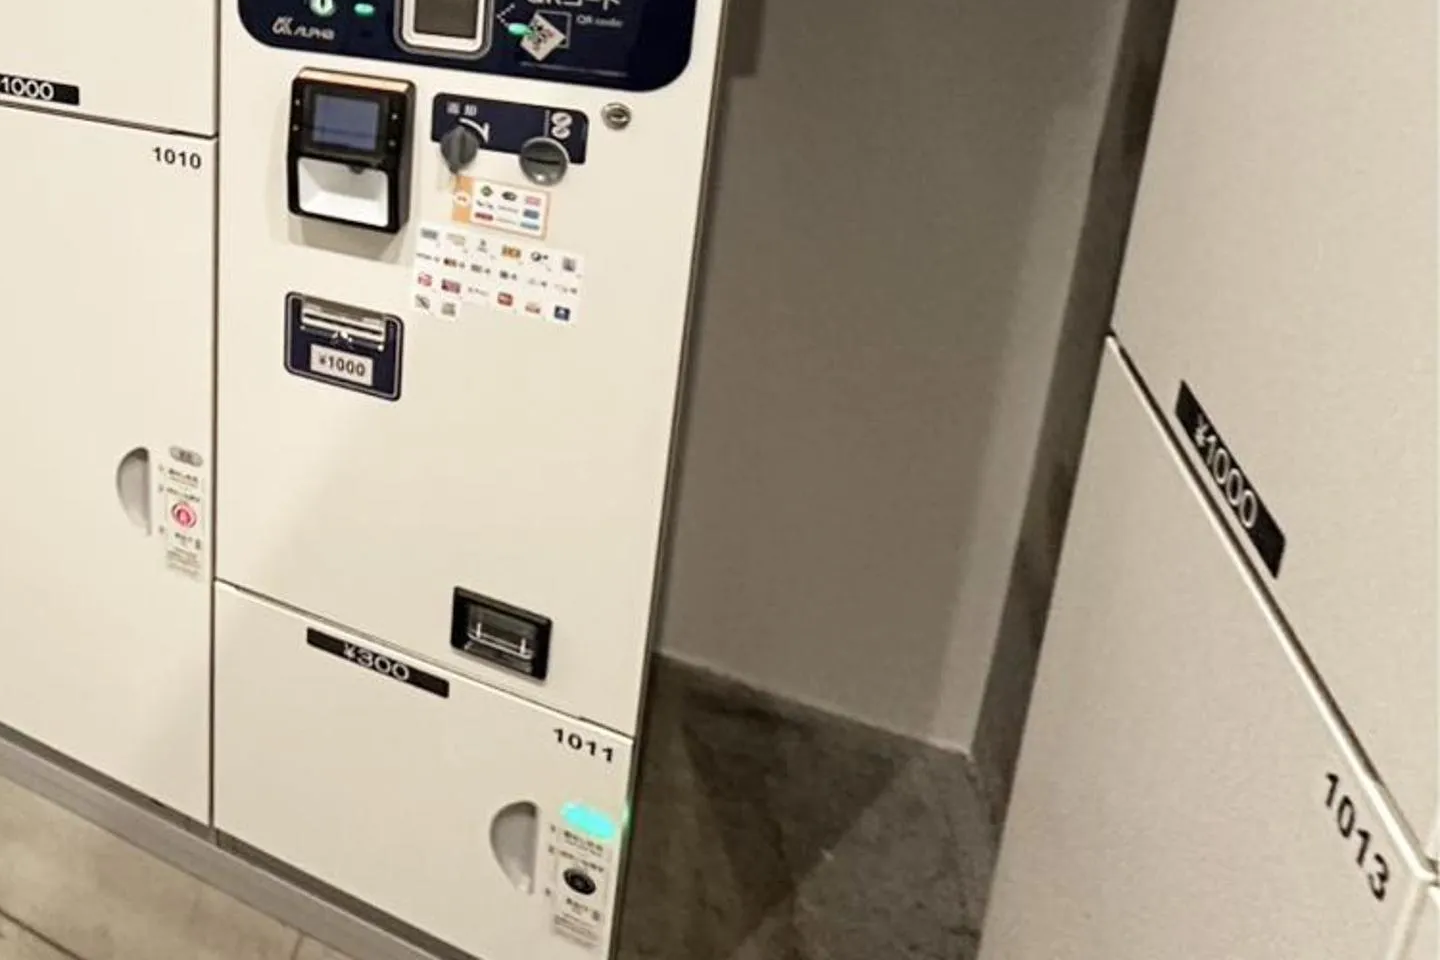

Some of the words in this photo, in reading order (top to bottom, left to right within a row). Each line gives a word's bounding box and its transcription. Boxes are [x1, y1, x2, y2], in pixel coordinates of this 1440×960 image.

[151, 146, 203, 170] 1010
[317, 353, 366, 378] ¥1000
[1195, 414, 1259, 530] ¥1000
[343, 643, 411, 683] ¥300
[553, 727, 615, 763] 1011
[1324, 772, 1391, 903] 1013
